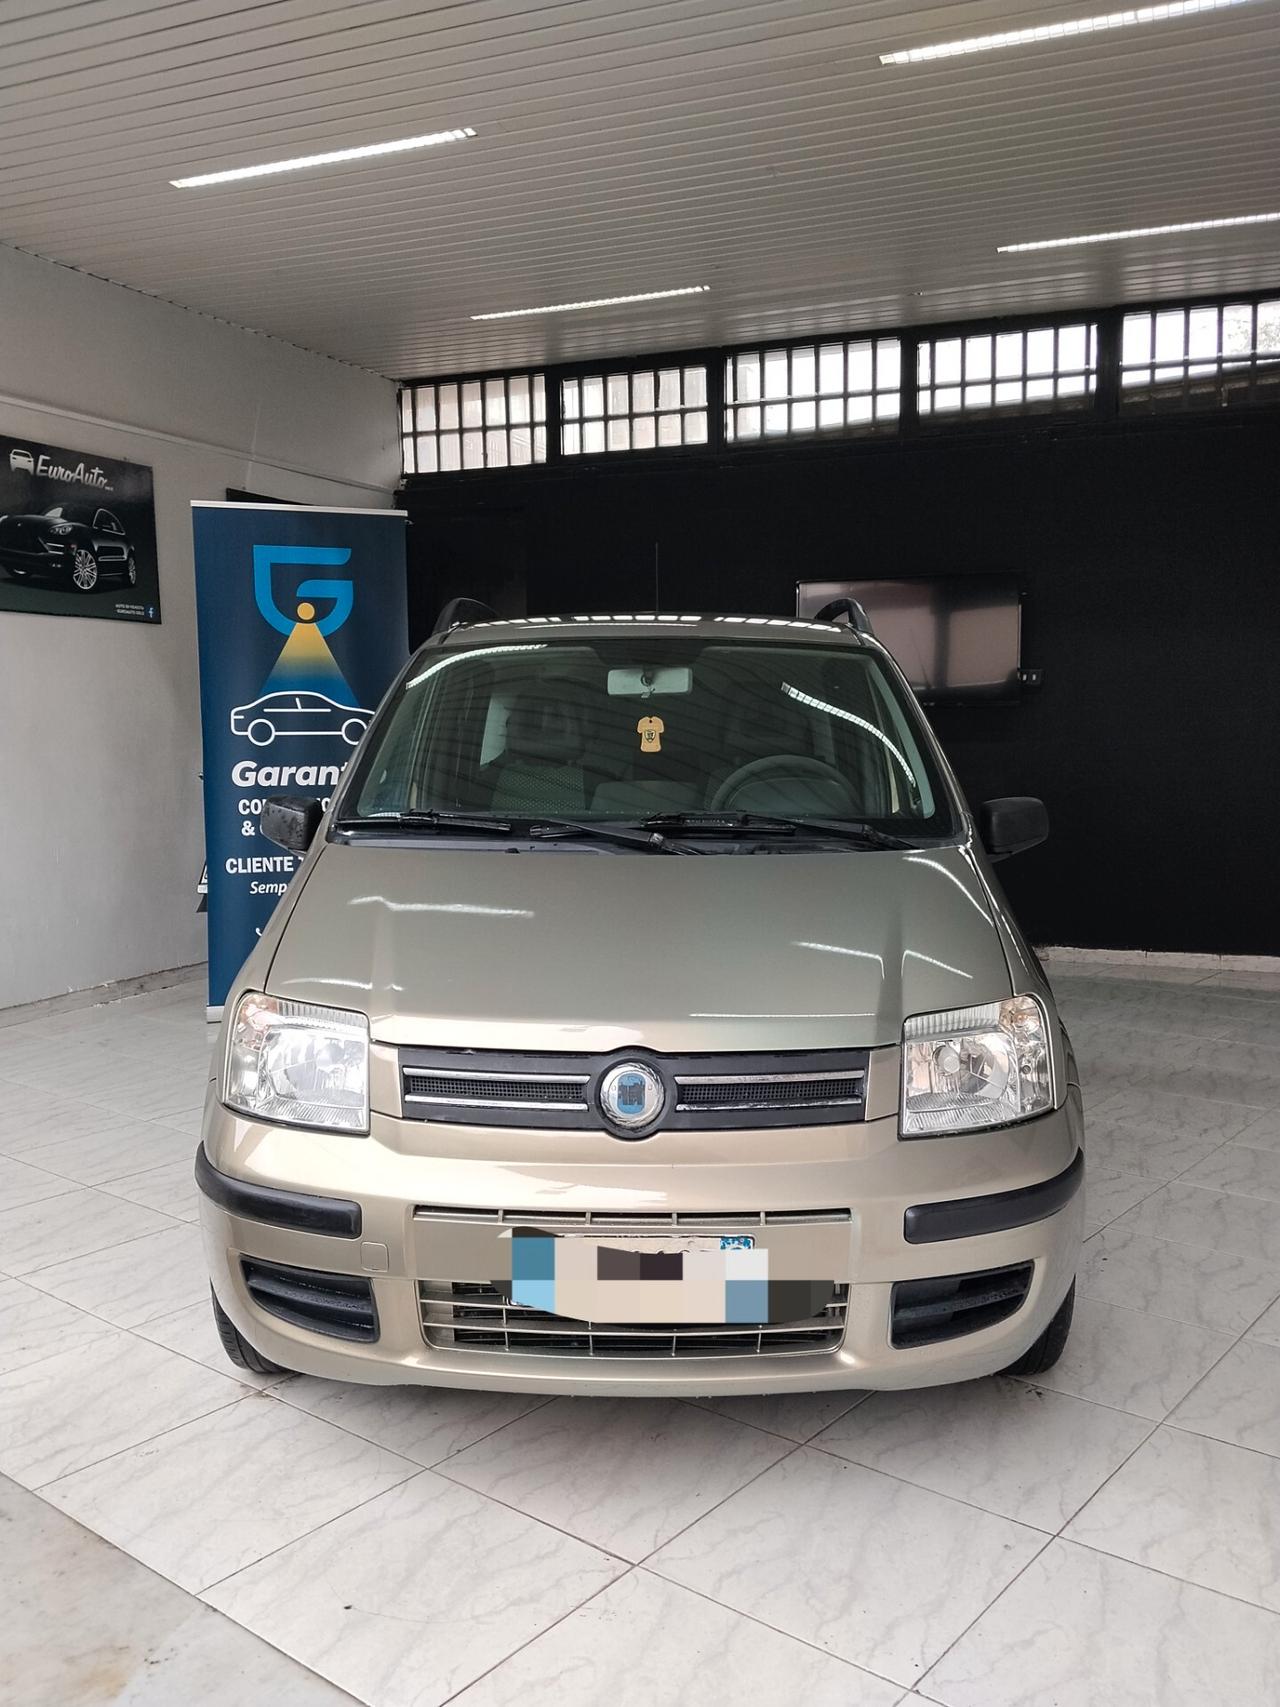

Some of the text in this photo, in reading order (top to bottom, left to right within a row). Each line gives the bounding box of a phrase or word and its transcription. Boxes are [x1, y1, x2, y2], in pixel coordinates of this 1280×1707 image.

[37, 455, 107, 488] EuroAuto
[241, 820, 256, 836] &
[225, 856, 294, 874] CLIENTE
[249, 881, 288, 896] Semp
